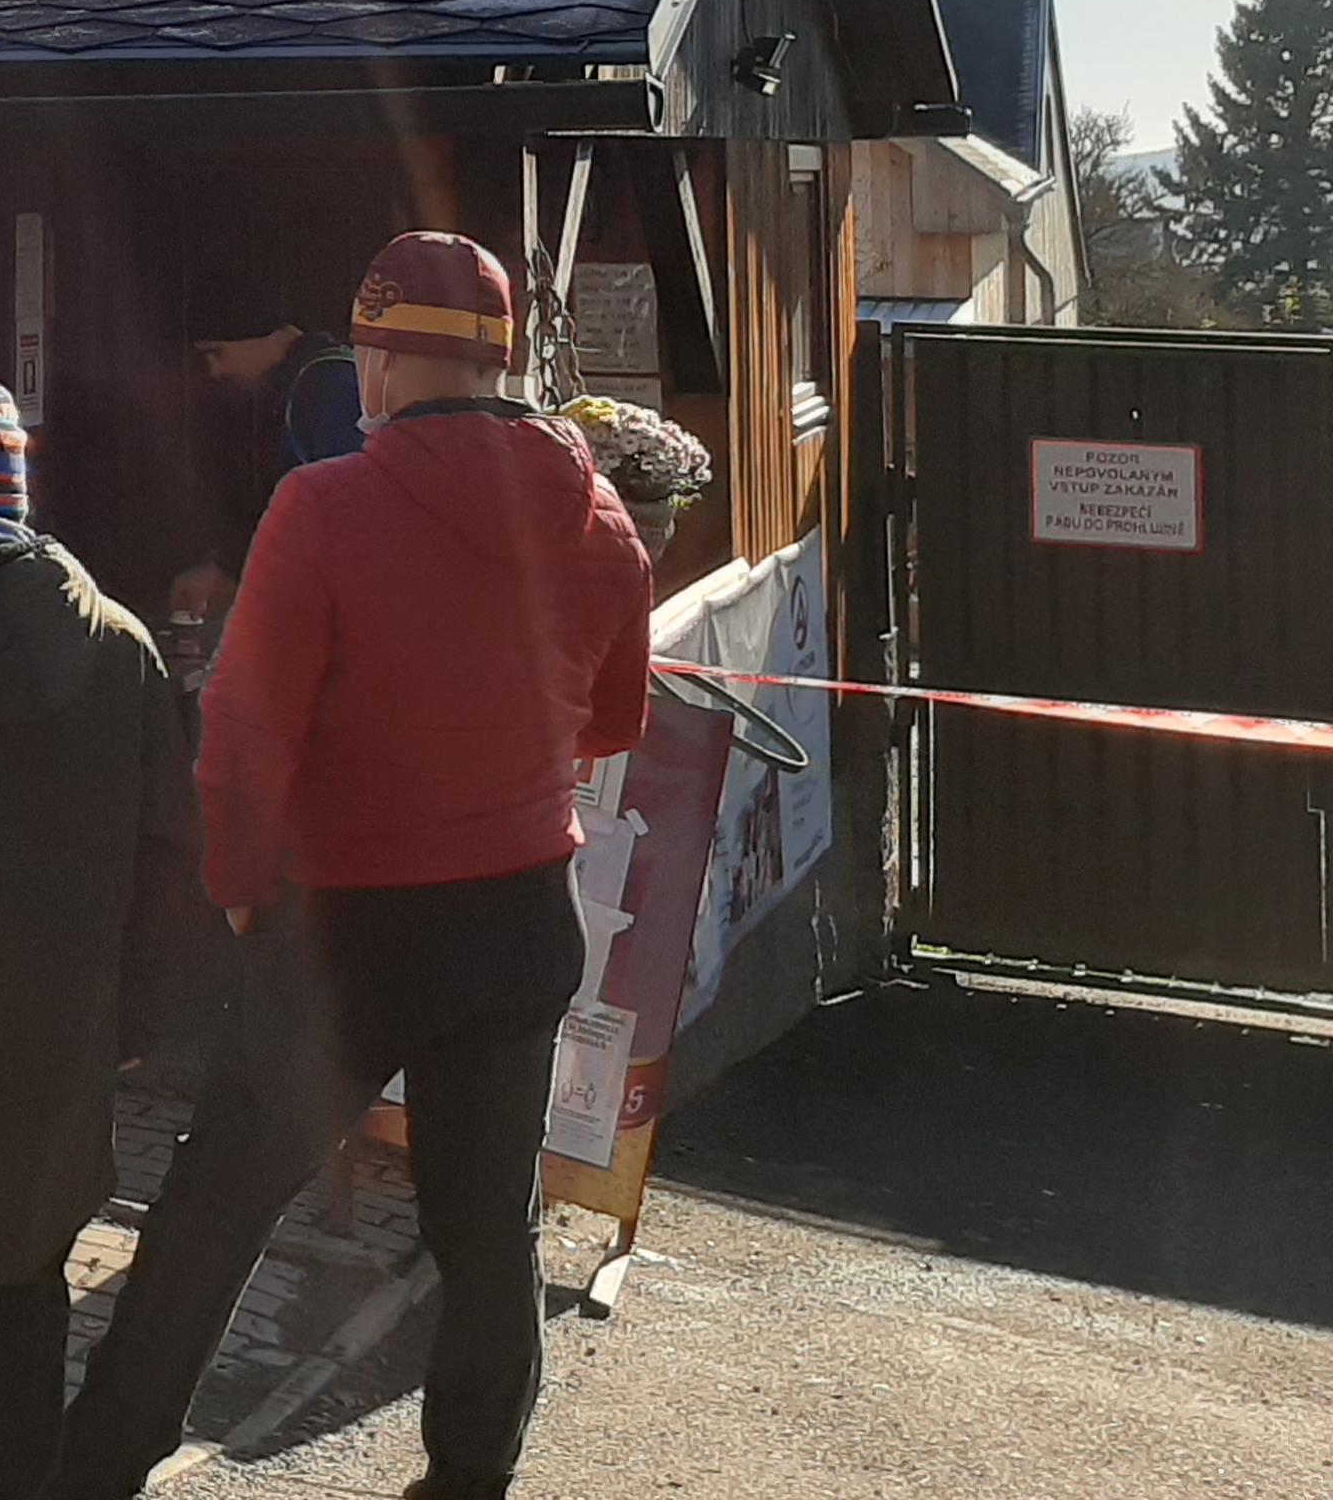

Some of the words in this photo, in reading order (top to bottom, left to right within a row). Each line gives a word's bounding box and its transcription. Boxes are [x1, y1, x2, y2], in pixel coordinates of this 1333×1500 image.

[1086, 451, 1140, 465] POZOR
[1049, 481, 1100, 493] VSTUP
[1084, 518, 1104, 531] DO
